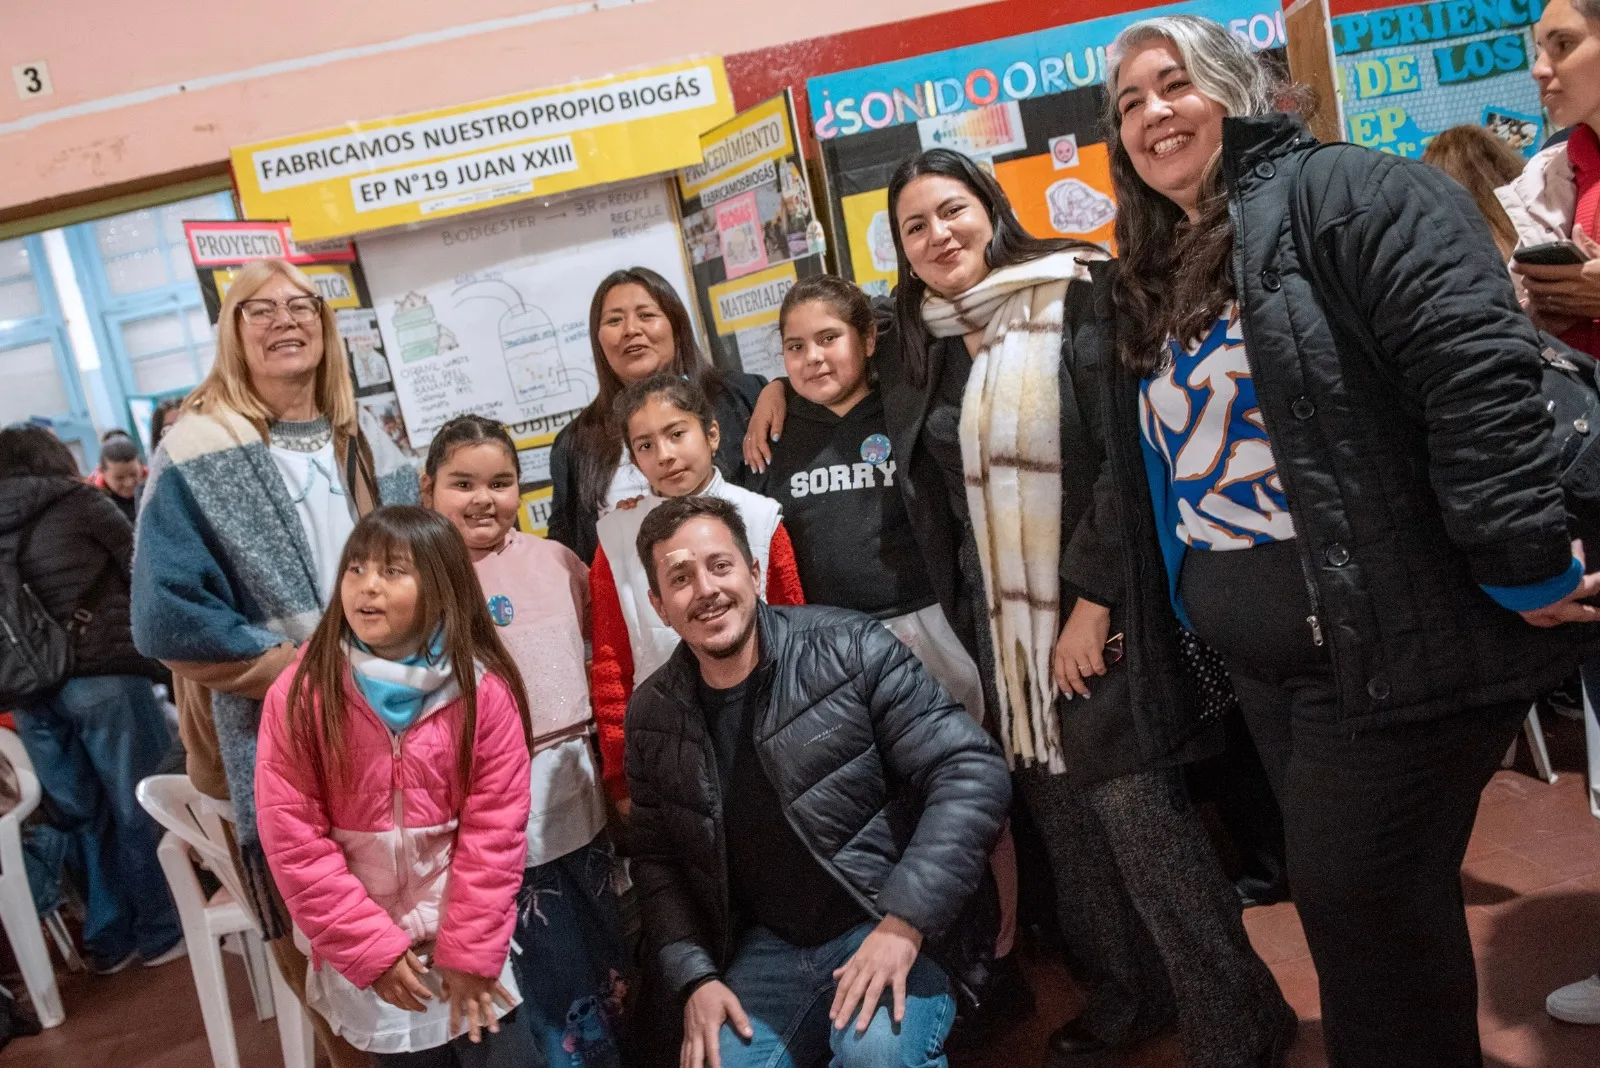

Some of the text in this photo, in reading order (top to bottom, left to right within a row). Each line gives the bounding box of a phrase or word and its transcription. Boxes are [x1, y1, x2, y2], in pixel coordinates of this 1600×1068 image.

[23, 67, 42, 93] 3
[1355, 54, 1419, 98] DE
[1434, 35, 1525, 83] LOS
[261, 76, 701, 180] FABRICAMOS NUESTRO PROPIO BIOGÁS
[1349, 107, 1407, 147] EP
[360, 181, 387, 203] EP
[457, 154, 516, 186] JUAN
[522, 143, 573, 172] XXIII
[195, 233, 282, 257] PROYECTO
[790, 460, 897, 498] SORRY
